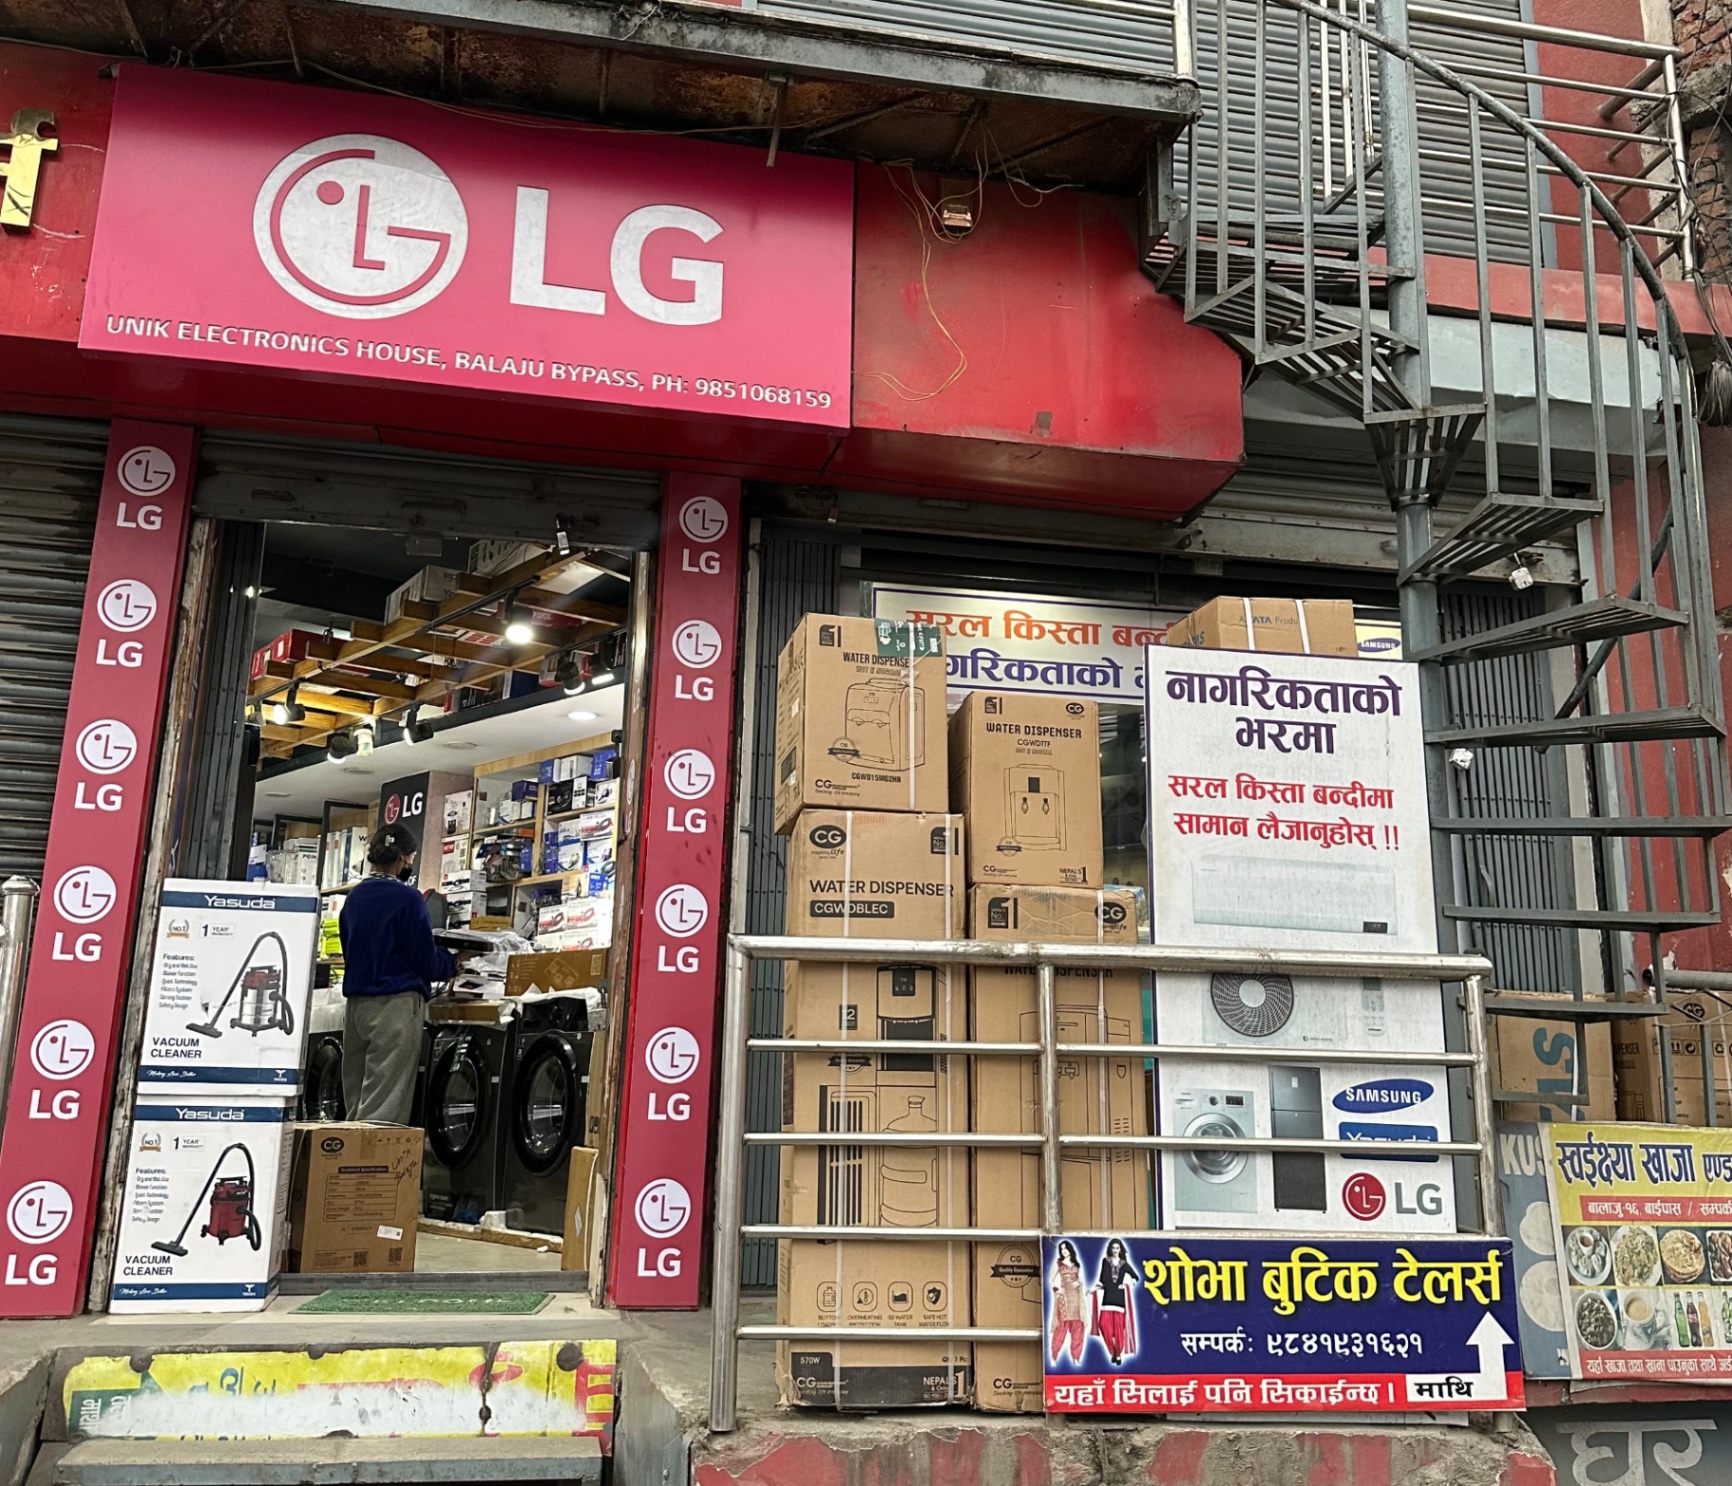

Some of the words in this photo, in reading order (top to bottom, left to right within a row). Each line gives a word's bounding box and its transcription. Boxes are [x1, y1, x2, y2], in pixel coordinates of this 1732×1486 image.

[510, 184, 725, 328] LG
[107, 315, 170, 340] UNIK
[177, 320, 350, 357] ELECTRONICS
[357, 341, 448, 371] HOUSE,
[455, 351, 545, 379] BALAJU
[551, 361, 644, 391] BYPASS,
[652, 373, 690, 396] PH:
[695, 377, 833, 410] 9851068159
[116, 503, 162, 530] LG
[682, 548, 721, 574] LG
[1003, 609, 1102, 645] किस्ता
[96, 639, 143, 668] LG
[1361, 640, 1396, 650] SAMSUNG
[843, 651, 870, 665] WATER
[872, 654, 911, 668] DISPENSE
[945, 647, 1123, 688] गरिकताको
[675, 675, 714, 701] LG
[1166, 665, 1402, 716] नागरिकताको
[1067, 704, 1083, 713] CG
[986, 722, 1021, 735] WATER
[1024, 724, 1082, 739] DISPENSER
[1235, 717, 1337, 754] भरमा
[74, 782, 123, 811] LG
[814, 778, 832, 790] CG
[1168, 774, 1229, 799] सरल
[1235, 772, 1306, 804] किस्ता
[1313, 780, 1395, 809] बन्दीमा
[402, 792, 424, 818] LG
[666, 807, 708, 834] LG
[1173, 812, 1250, 837] सामान
[1257, 811, 1377, 850] लैजानुहोस्
[814, 829, 842, 844] CG
[983, 864, 996, 873] CG
[204, 894, 276, 909] Yasuda
[809, 879, 866, 894] WATER
[869, 880, 955, 898] DISPENSER
[51, 932, 102, 962] LG
[657, 946, 700, 973] LG
[1004, 965, 1036, 975] WATE
[150, 1048, 202, 1059] CLEANER
[152, 1037, 200, 1048] VACUUM
[28, 1090, 80, 1119] LG
[647, 1093, 691, 1121] LG
[1345, 1087, 1422, 1104] SAMSUNG
[176, 1107, 245, 1121] Yasuda
[323, 1139, 342, 1151] CG
[1639, 1143, 1696, 1184] खाजा
[1394, 1182, 1443, 1216] LG
[1644, 1199, 1682, 1216] बाईपास
[5, 1254, 57, 1286] LG
[123, 1266, 173, 1276] CLEANER
[125, 1255, 171, 1265] VACUUM
[637, 1248, 682, 1278] LG
[1009, 1255, 1022, 1263] CG
[1143, 1247, 1249, 1305] शोभा
[1263, 1246, 1378, 1315] बुटिक
[1393, 1248, 1504, 1305] टेलर्स
[1180, 1326, 1254, 1356] सम्पर्क:
[1266, 1332, 1424, 1359] ९८४१९३१६२१
[800, 1356, 820, 1365] 570W
[796, 1376, 817, 1388] CG
[993, 1377, 1012, 1389] CG
[1054, 1376, 1105, 1405] यहाँ
[1113, 1378, 1195, 1405] सिलाई
[1204, 1380, 1255, 1405] पनि
[1261, 1380, 1381, 1405] सिकाईन्छ
[1413, 1379, 1474, 1399] माथि
